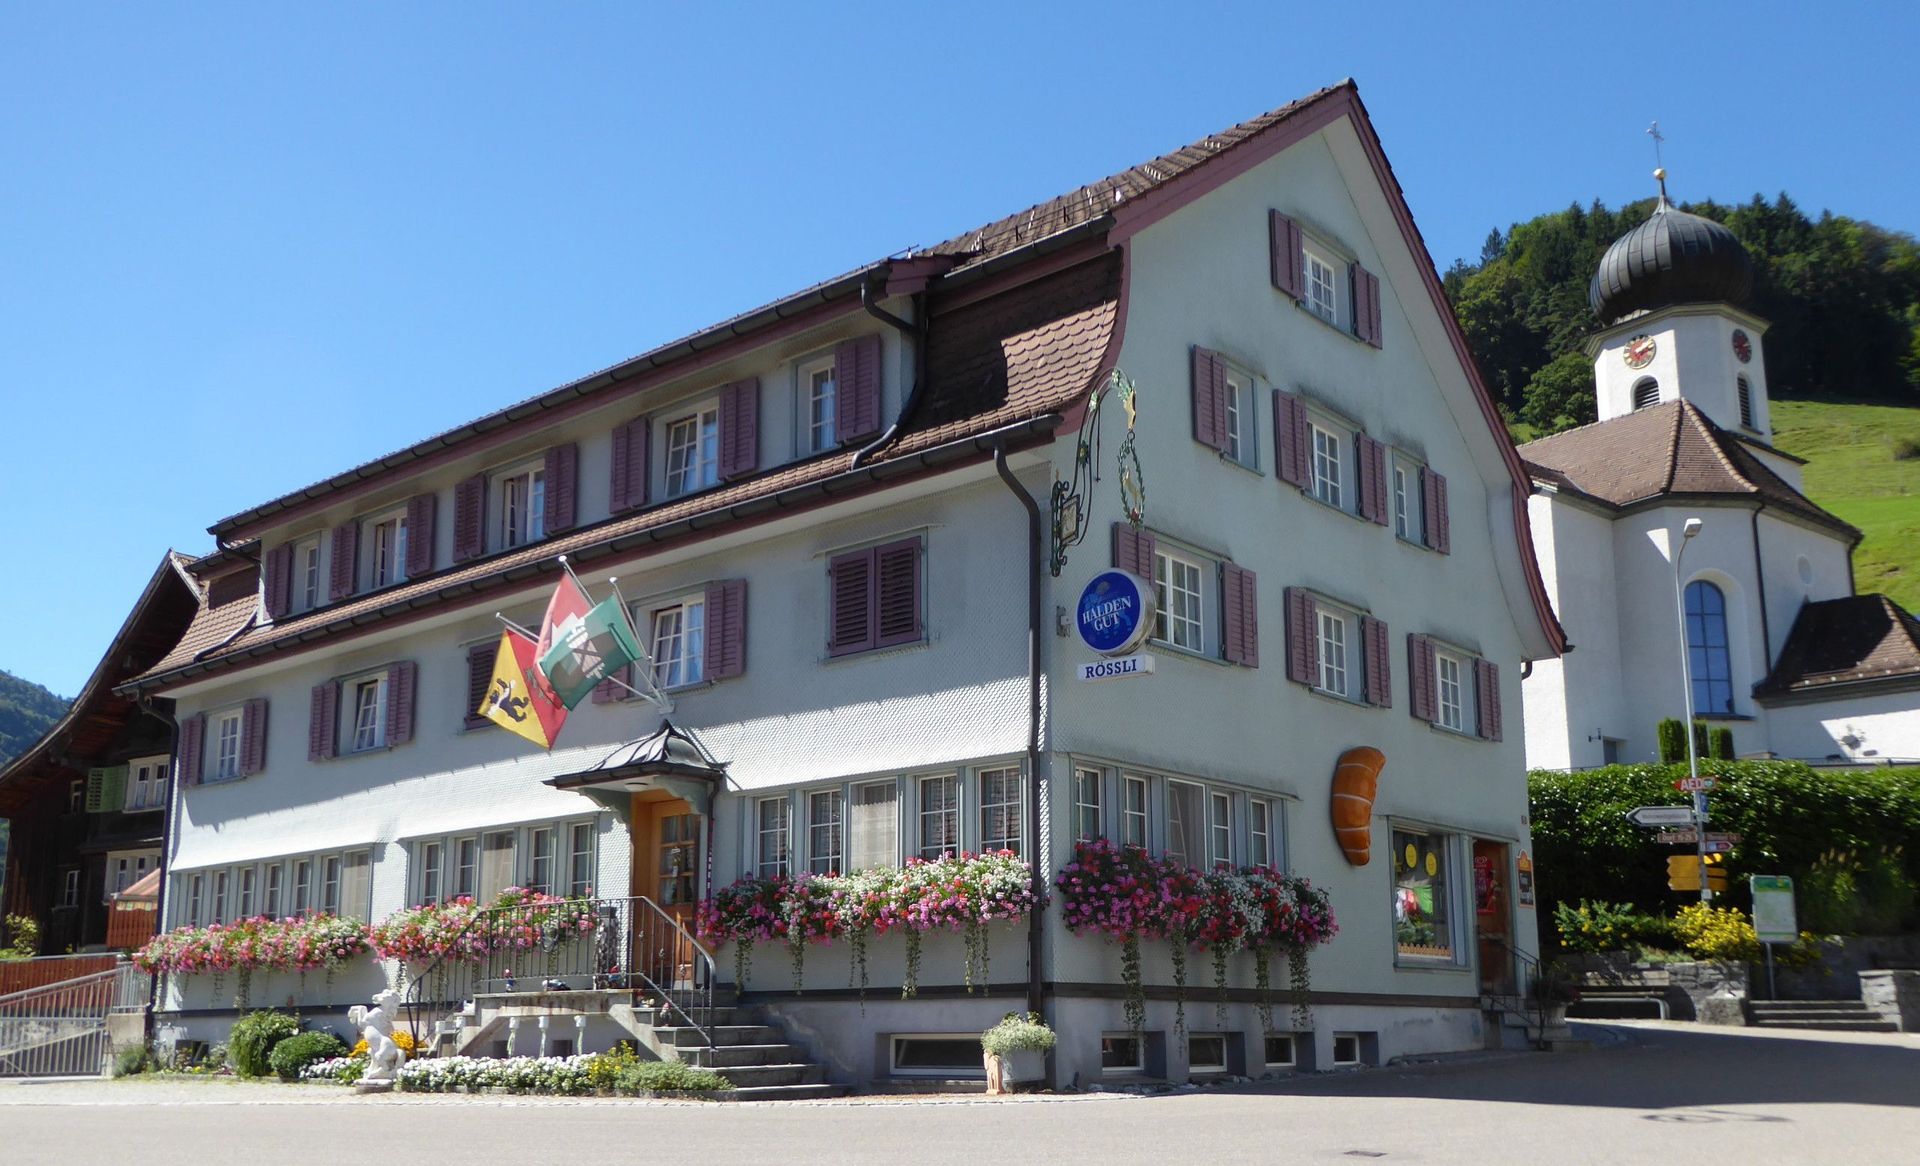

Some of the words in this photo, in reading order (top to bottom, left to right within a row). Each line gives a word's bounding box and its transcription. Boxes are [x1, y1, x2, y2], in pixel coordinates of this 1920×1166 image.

[1083, 596, 1132, 624] HALDEN
[1094, 612, 1120, 631] GUT
[1085, 659, 1137, 679] RÖSSLI
[1680, 778, 1702, 791] AED
